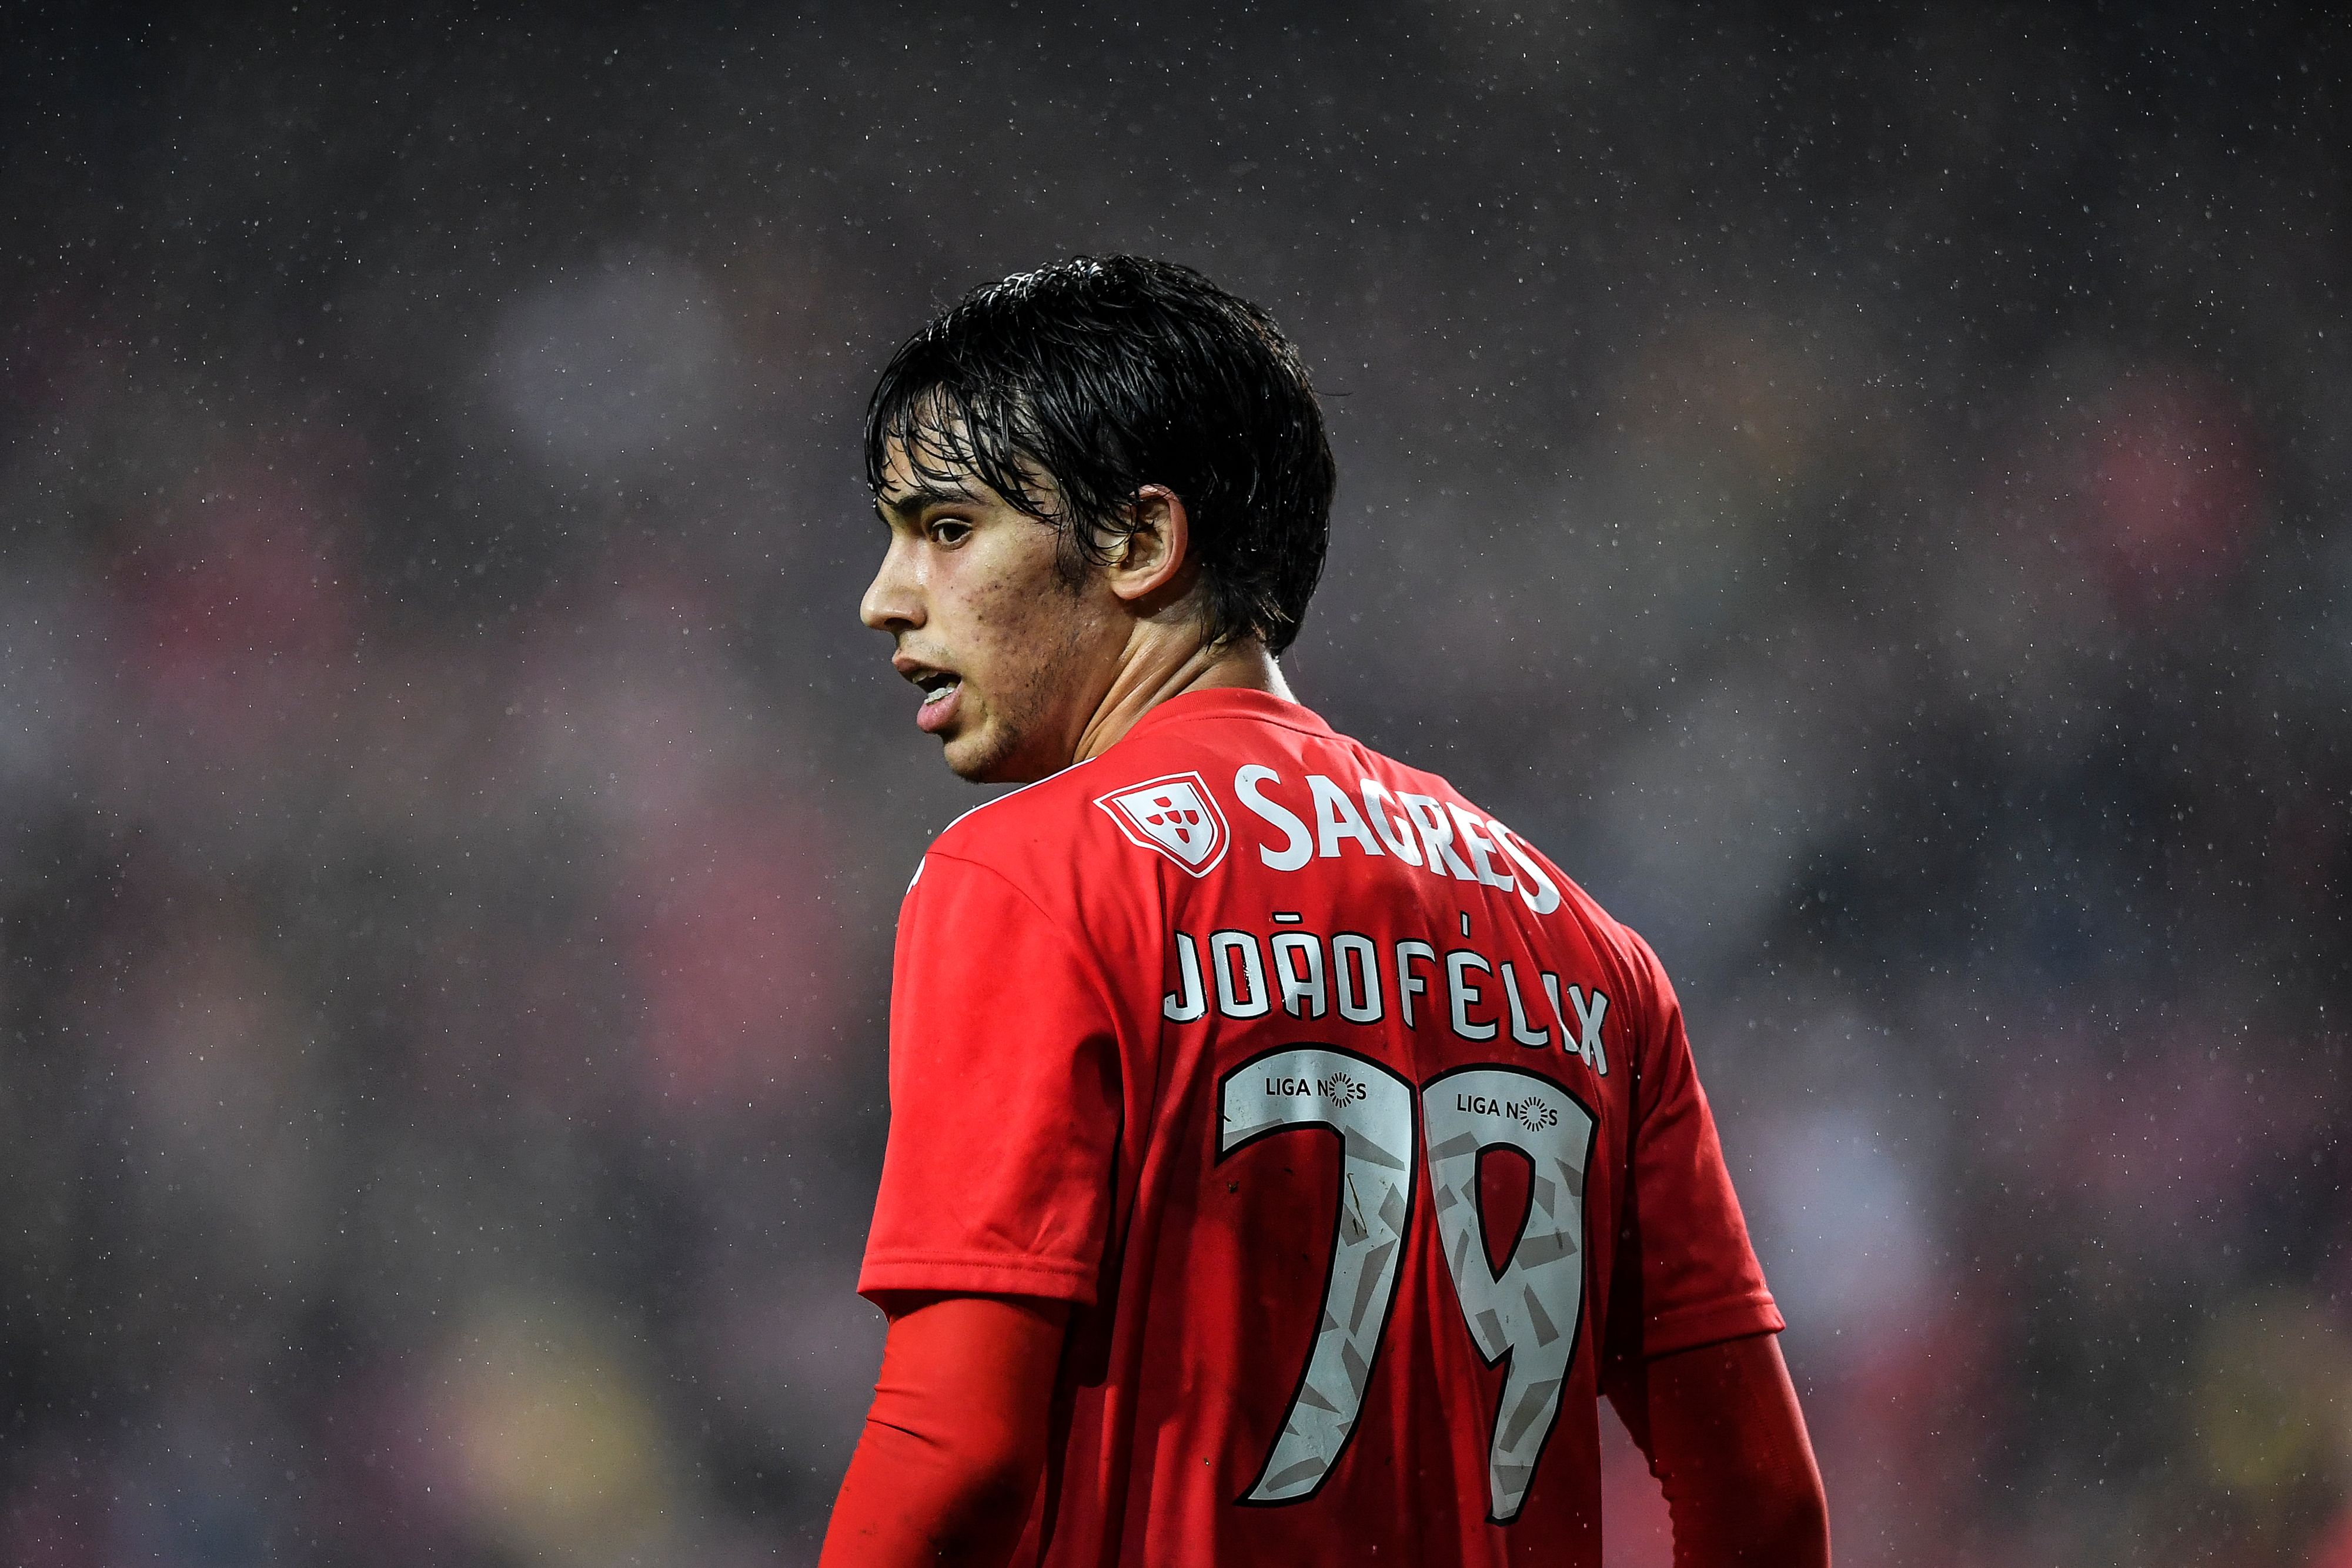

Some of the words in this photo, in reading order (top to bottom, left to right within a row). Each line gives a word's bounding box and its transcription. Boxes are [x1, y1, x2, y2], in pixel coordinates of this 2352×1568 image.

[1233, 764, 1561, 915] SAGRES
[1395, 911, 1610, 1078] FÉLIX
[1265, 1077, 1311, 1096] LIGA
[1317, 1071, 1367, 1109] NOS
[1456, 1093, 1501, 1117] LIGA
[1505, 1095, 1558, 1132] NOS
[1214, 1041, 1600, 1527] 79
